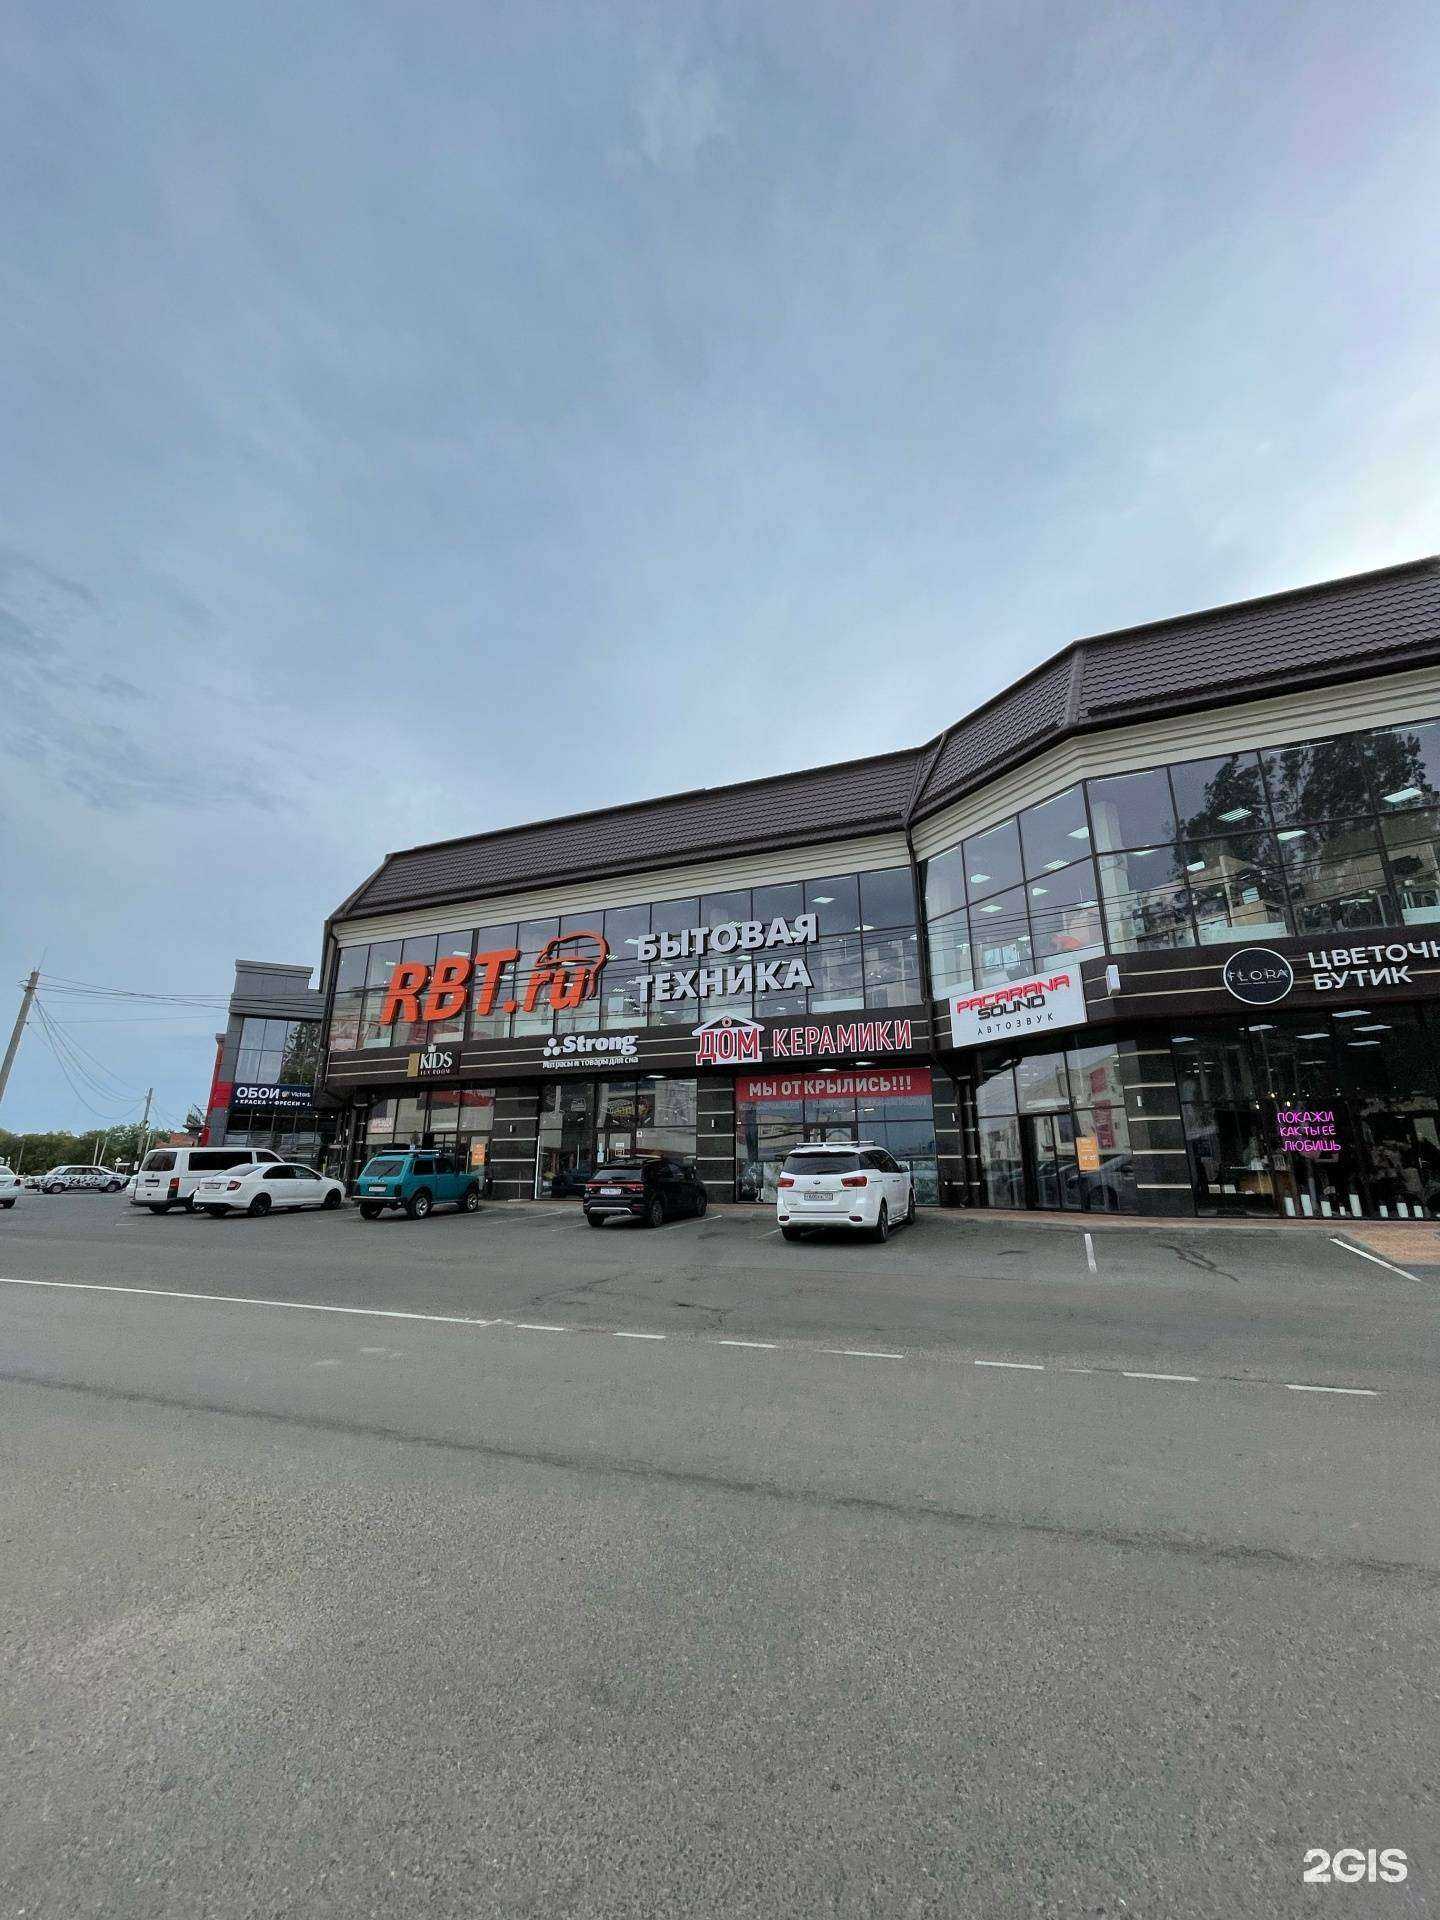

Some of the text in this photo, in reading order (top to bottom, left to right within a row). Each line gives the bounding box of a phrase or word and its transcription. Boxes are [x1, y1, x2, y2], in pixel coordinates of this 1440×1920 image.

[637, 913, 819, 962] БЫТОВАЯ
[635, 958, 814, 1004] ТЕХНИКА
[1228, 968, 1289, 982] FLORA
[1313, 965, 1414, 991] БУТИК
[380, 948, 592, 1025] RBT.ru
[956, 974, 1070, 1014] PACARANA
[977, 994, 1046, 1020] SOUND
[977, 1012, 1054, 1036] АВТОЗВУК
[562, 1035, 639, 1055] Strong
[696, 1019, 913, 1065] ДОМ КЕРАМИКИ
[420, 1051, 453, 1070] KIDS
[581, 1058, 608, 1067] товары
[624, 1056, 639, 1064] сна
[236, 1086, 280, 1099] ОБОИ
[750, 1081, 777, 1097] МЫ
[1277, 1111, 1335, 1123] ПОКАЖИ
[1280, 1126, 1303, 1137] КАК
[1303, 1126, 1320, 1137] ТЫ
[1281, 1139, 1342, 1152] ЛЮБИШЬ
